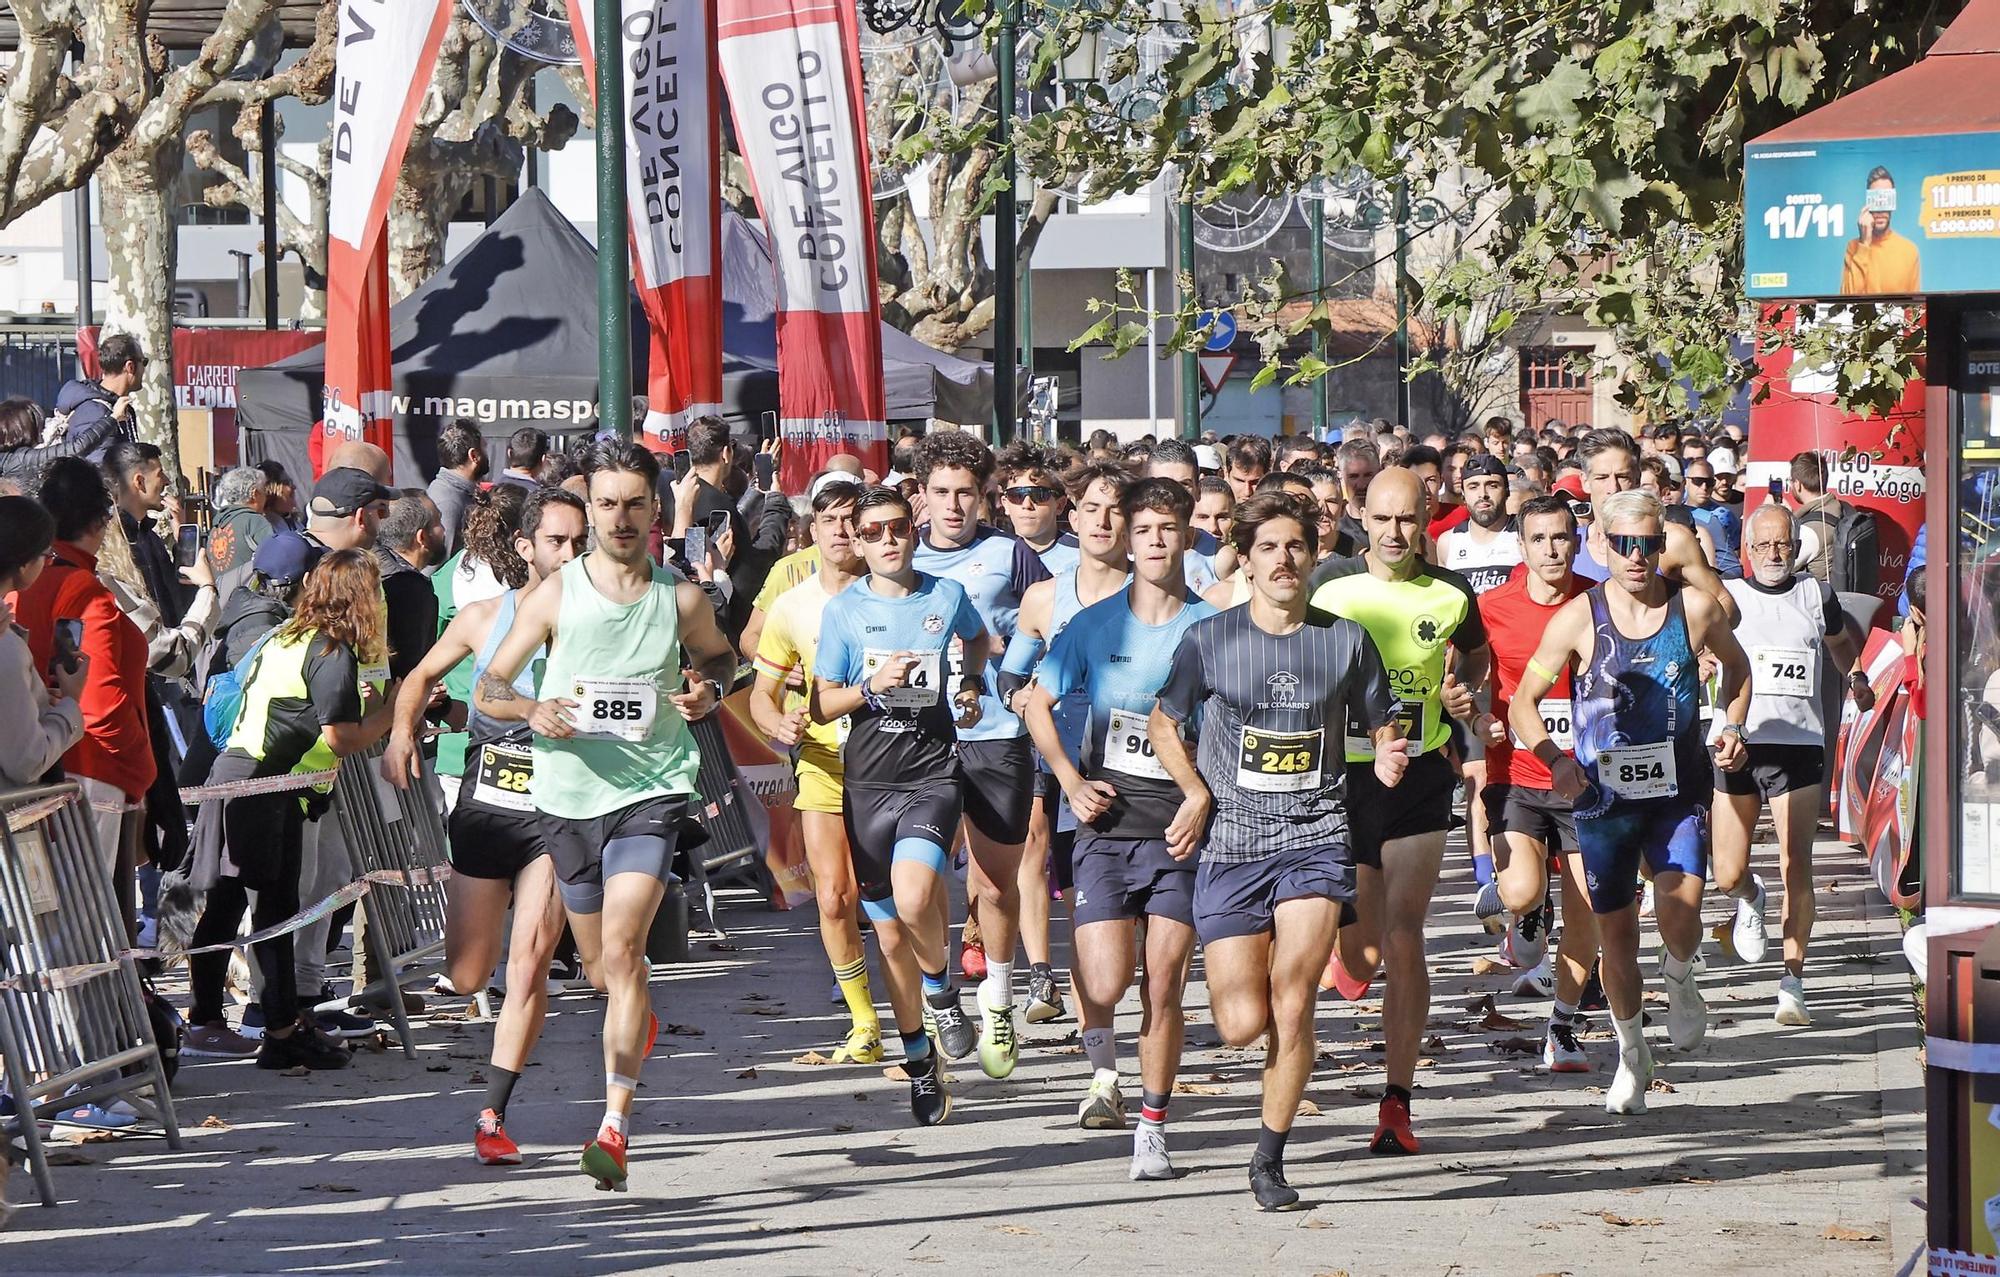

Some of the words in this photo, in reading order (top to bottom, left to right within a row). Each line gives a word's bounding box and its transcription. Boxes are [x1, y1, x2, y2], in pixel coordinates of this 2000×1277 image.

[343, 0, 385, 48] V
[335, 76, 361, 165] DE
[1786, 194, 1822, 205] SORTEO
[1764, 203, 1844, 240] 11/11
[1952, 209, 1980, 217] PREMIOS
[194, 386, 237, 409] POLA
[1839, 475, 1864, 495] de
[1875, 481, 1921, 503] xogo
[1771, 663, 1806, 680] 742
[592, 700, 643, 720] 885
[1544, 717, 1570, 734] 00
[1126, 735, 1156, 757] 90
[1261, 751, 1311, 772] 243
[496, 769, 534, 792] 28
[1619, 762, 1665, 783] 854
[1955, 1260, 1997, 1276] MANTENGA
